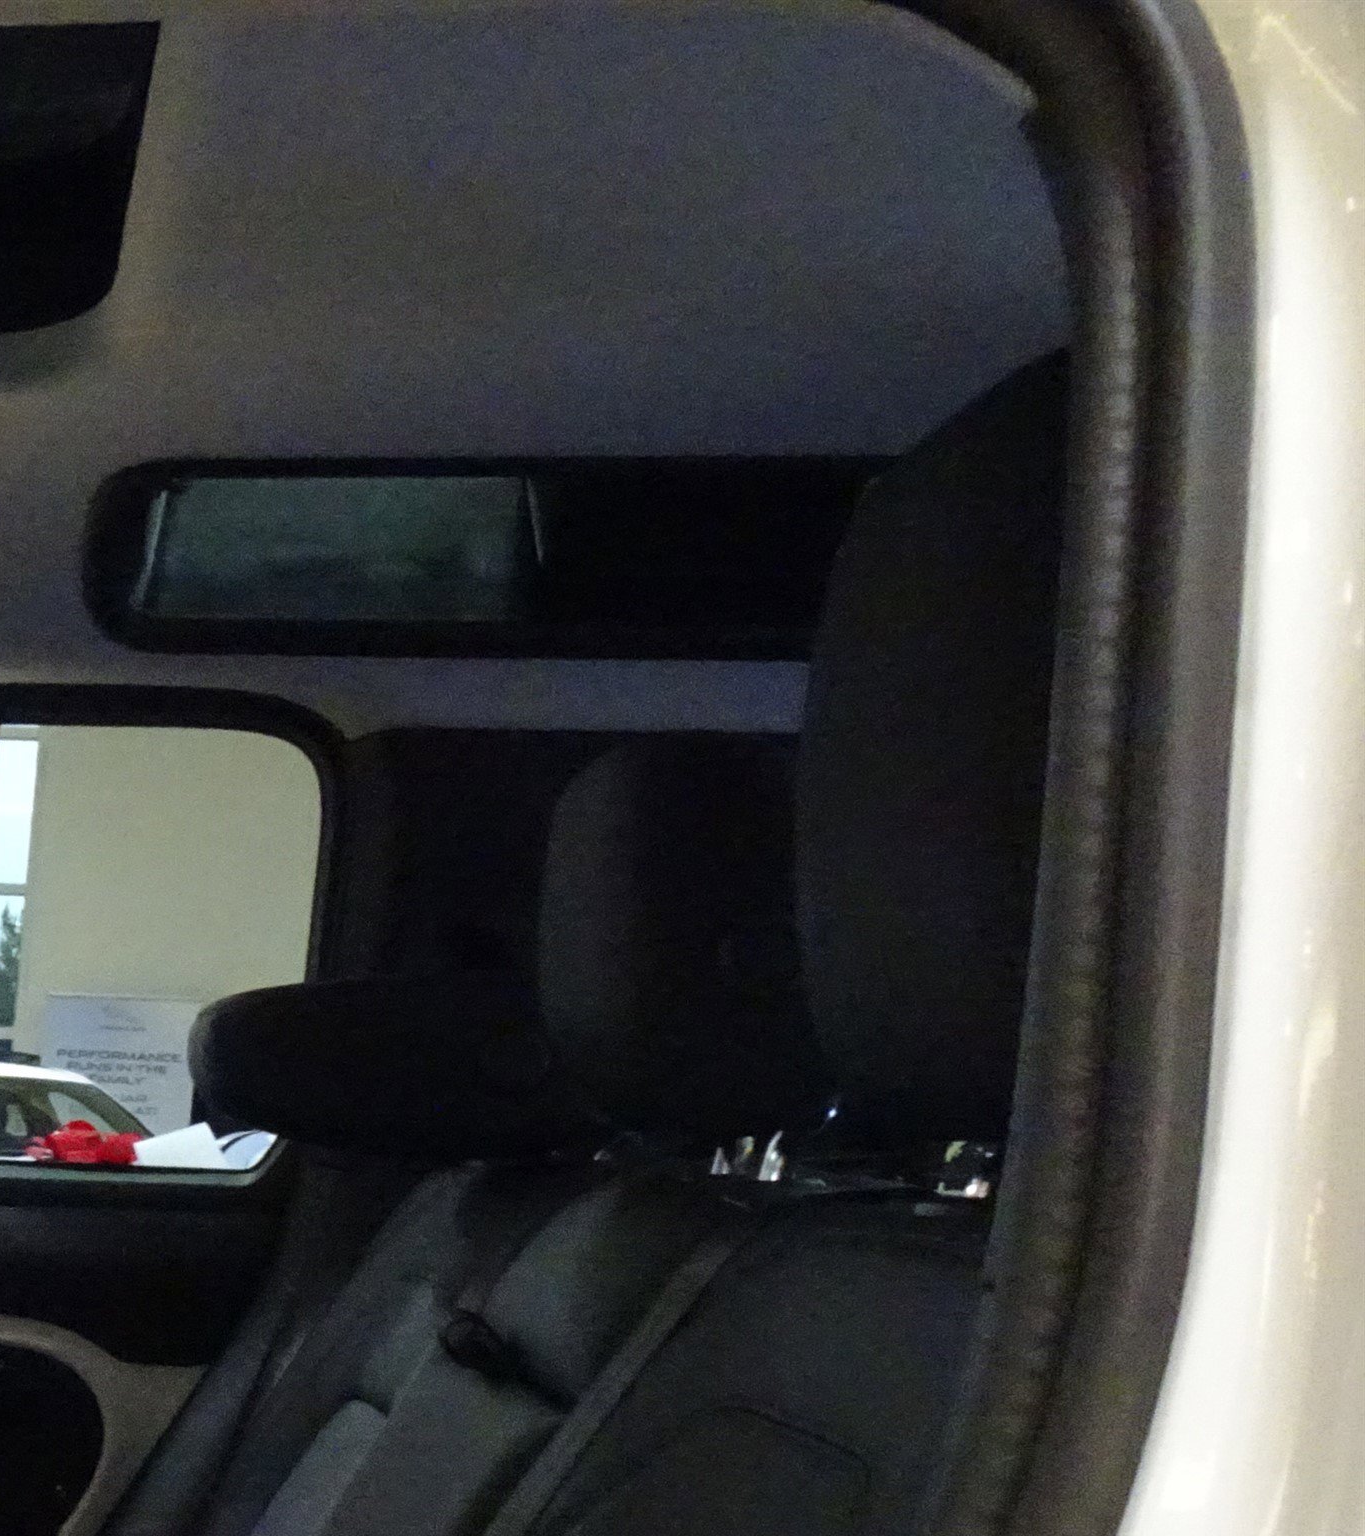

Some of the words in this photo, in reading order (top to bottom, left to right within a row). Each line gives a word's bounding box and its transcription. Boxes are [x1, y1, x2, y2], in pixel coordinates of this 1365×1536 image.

[56, 1048, 181, 1063] PERFORMANCE
[116, 1063, 131, 1073] IN
[136, 1064, 167, 1075] THE
